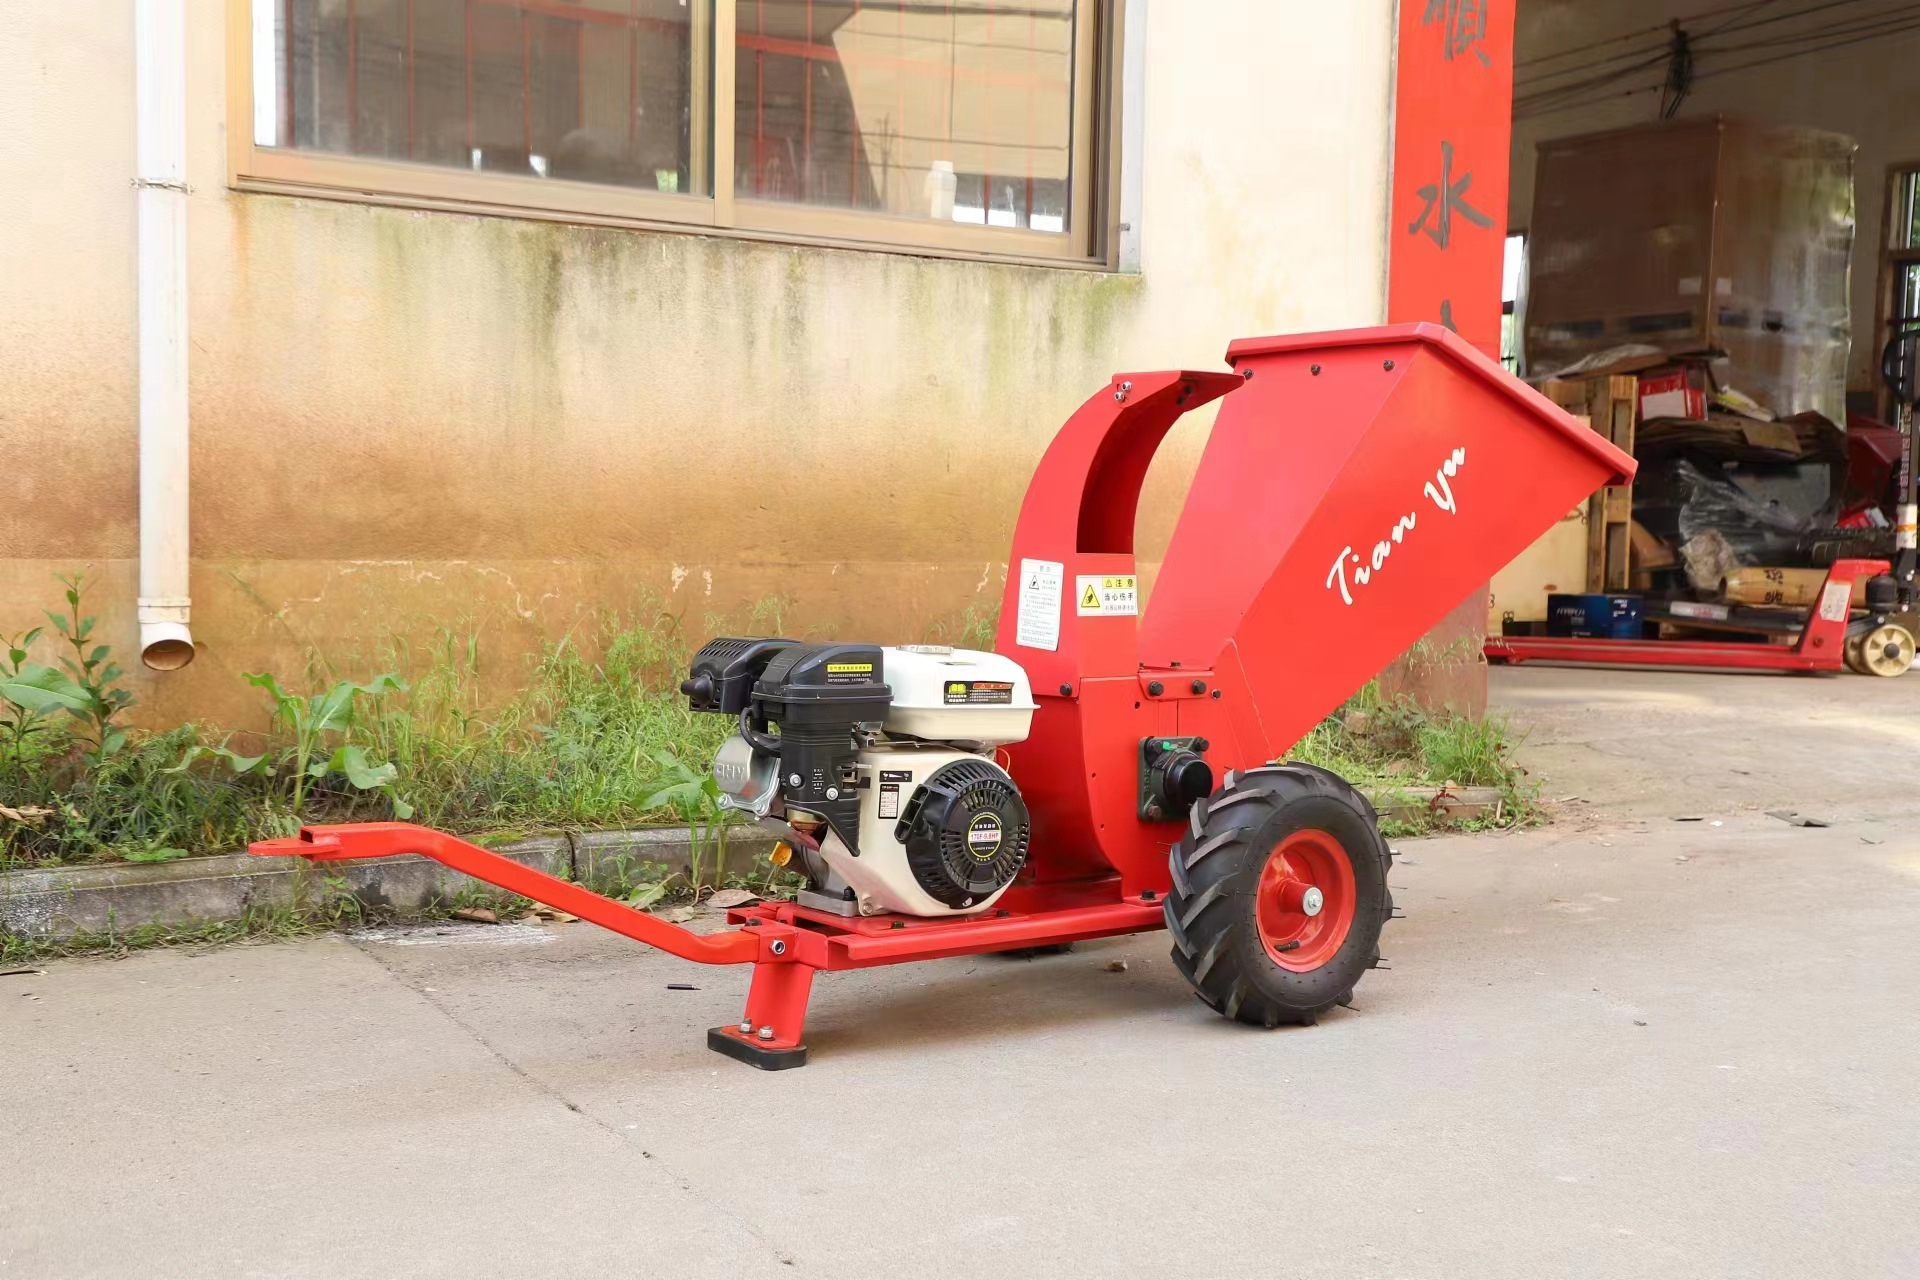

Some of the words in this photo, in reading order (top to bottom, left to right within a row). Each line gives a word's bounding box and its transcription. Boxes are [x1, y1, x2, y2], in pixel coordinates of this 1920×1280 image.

[1408, 0, 1495, 333] 順水
[1326, 511, 1416, 606] Tian
[1424, 446, 1466, 515] Yu
